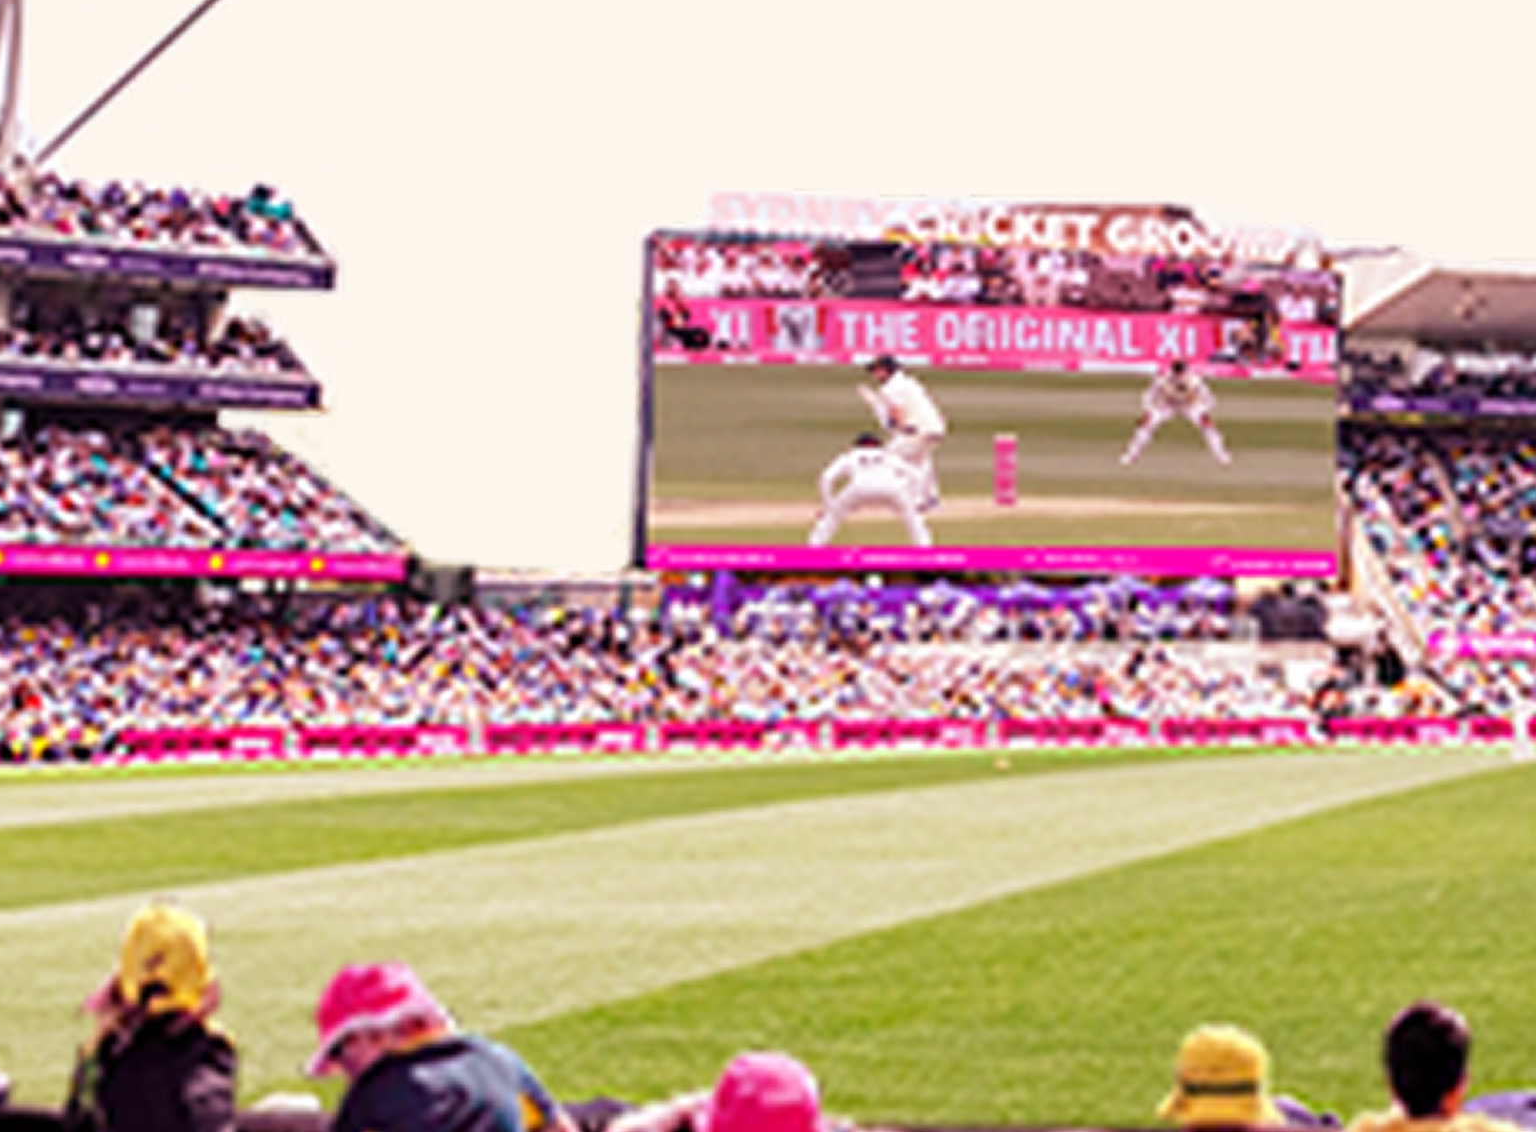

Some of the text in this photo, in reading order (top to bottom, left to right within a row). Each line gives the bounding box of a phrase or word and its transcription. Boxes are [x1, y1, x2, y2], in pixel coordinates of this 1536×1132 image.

[837, 311, 922, 351] THE
[934, 312, 1142, 358] ORIGINAL
[1156, 322, 1198, 359] XI
